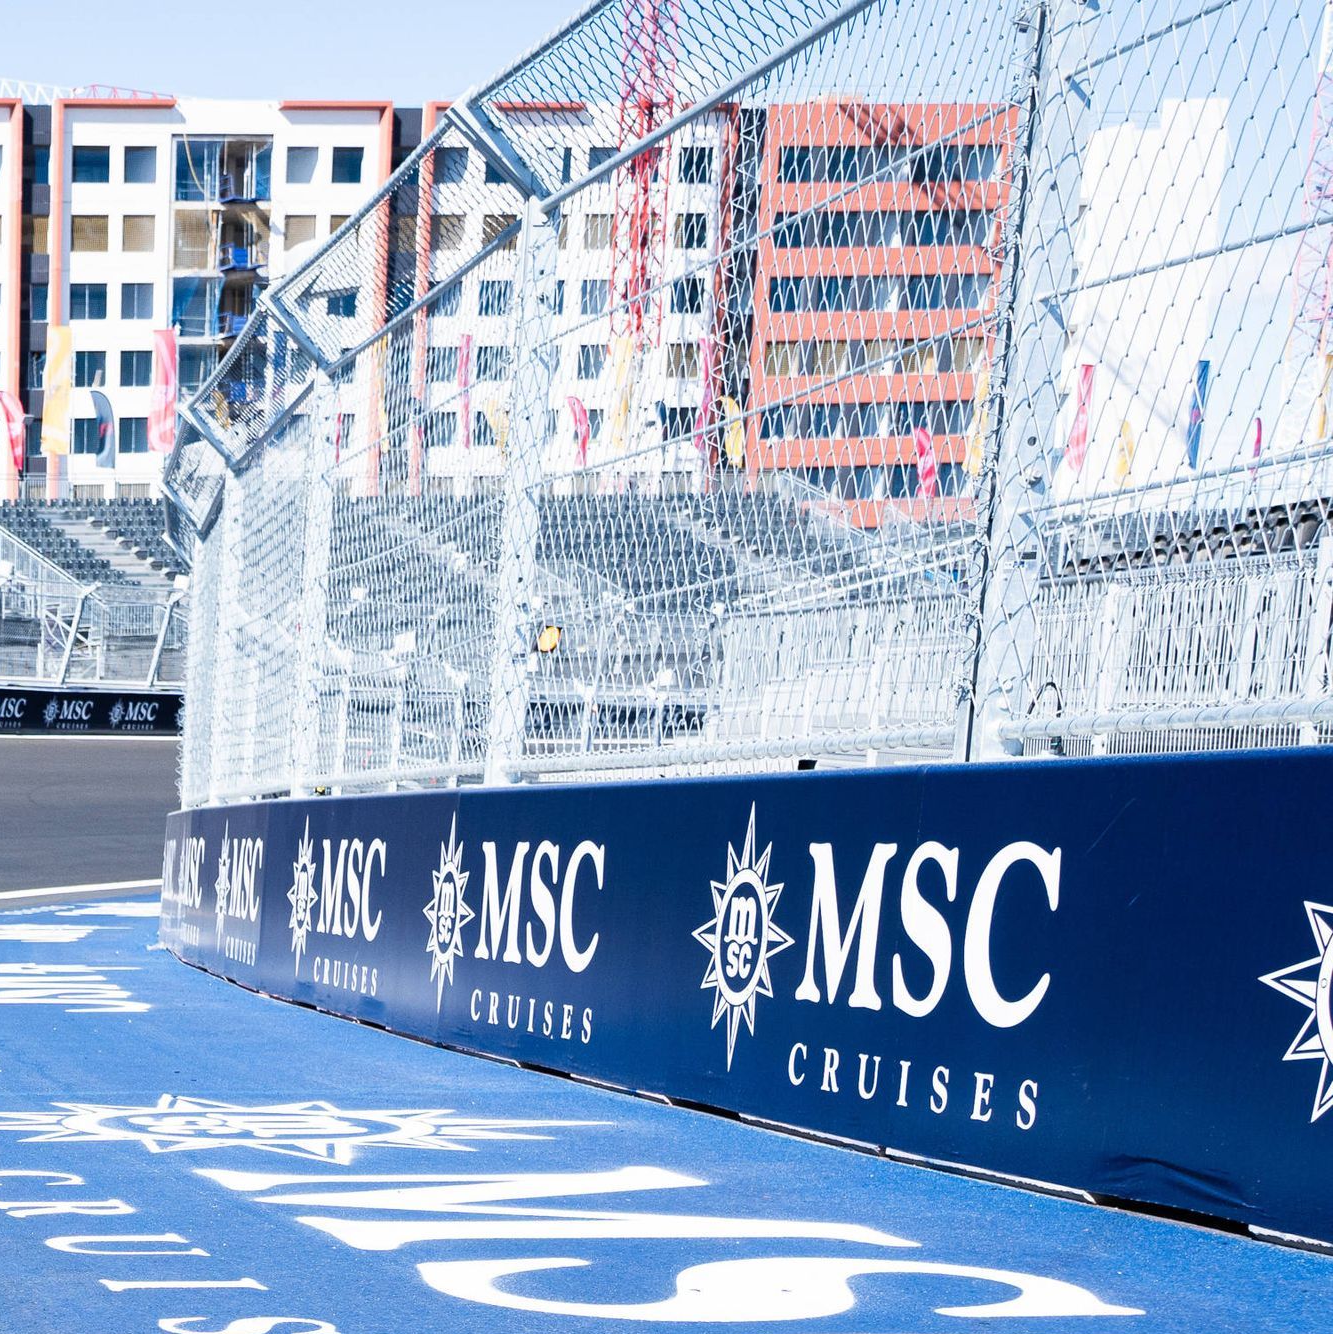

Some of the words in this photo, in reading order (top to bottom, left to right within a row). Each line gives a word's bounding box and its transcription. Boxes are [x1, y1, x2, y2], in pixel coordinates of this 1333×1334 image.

[59, 700, 93, 720] MSC
[125, 702, 158, 721] MSC
[228, 837, 263, 922] MSC
[317, 838, 386, 941] MSC
[474, 840, 604, 972] MSC
[226, 936, 255, 966] CRUISES
[795, 841, 1061, 1028] MSC
[314, 957, 377, 996] CRUISES
[471, 989, 592, 1043] CRUISES
[788, 1042, 1038, 1130] CRUISES
